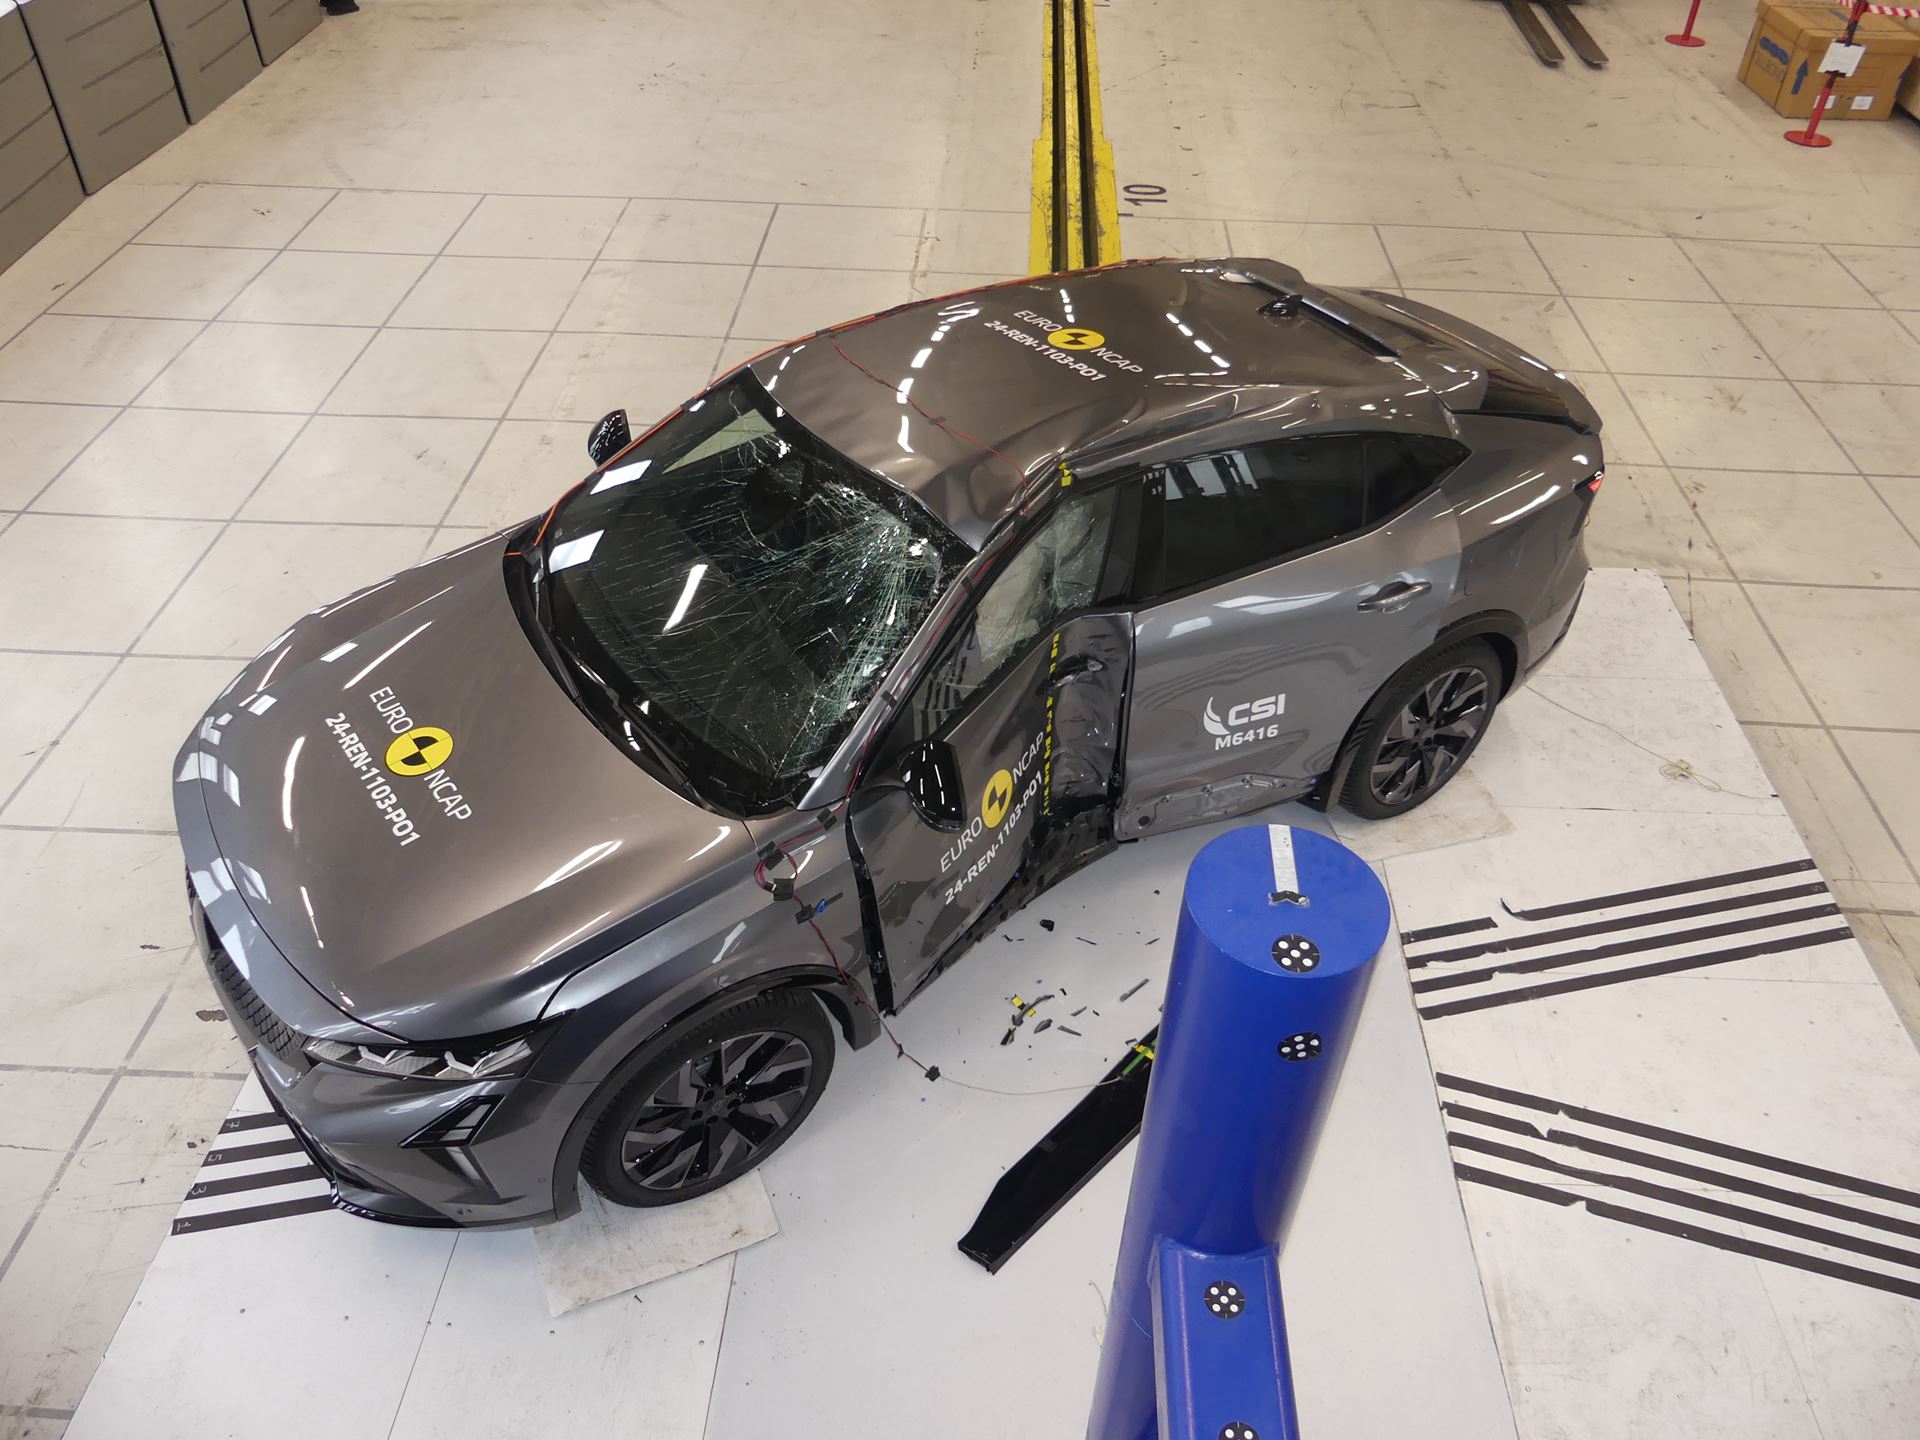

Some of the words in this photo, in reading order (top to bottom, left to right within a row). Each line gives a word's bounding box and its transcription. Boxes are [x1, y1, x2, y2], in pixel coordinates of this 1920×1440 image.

[1122, 184, 1168, 206] 10
[984, 319, 1107, 382] 24-REN-1103-P01
[1013, 310, 1063, 332] EURO
[1090, 347, 1144, 373] NCAP
[1228, 693, 1286, 727] CSI
[369, 686, 414, 734] EURO
[423, 768, 473, 820] NCAP
[1214, 724, 1279, 751] M6416
[325, 712, 421, 846] 24-REN-1103-P01
[940, 816, 983, 873] EURO
[1012, 731, 1044, 784] NCAP
[944, 770, 1042, 905] 24-REN-1103-P01
[225, 1120, 240, 1128] 7
[207, 1153, 222, 1162] 5
[191, 1184, 207, 1195] 3
